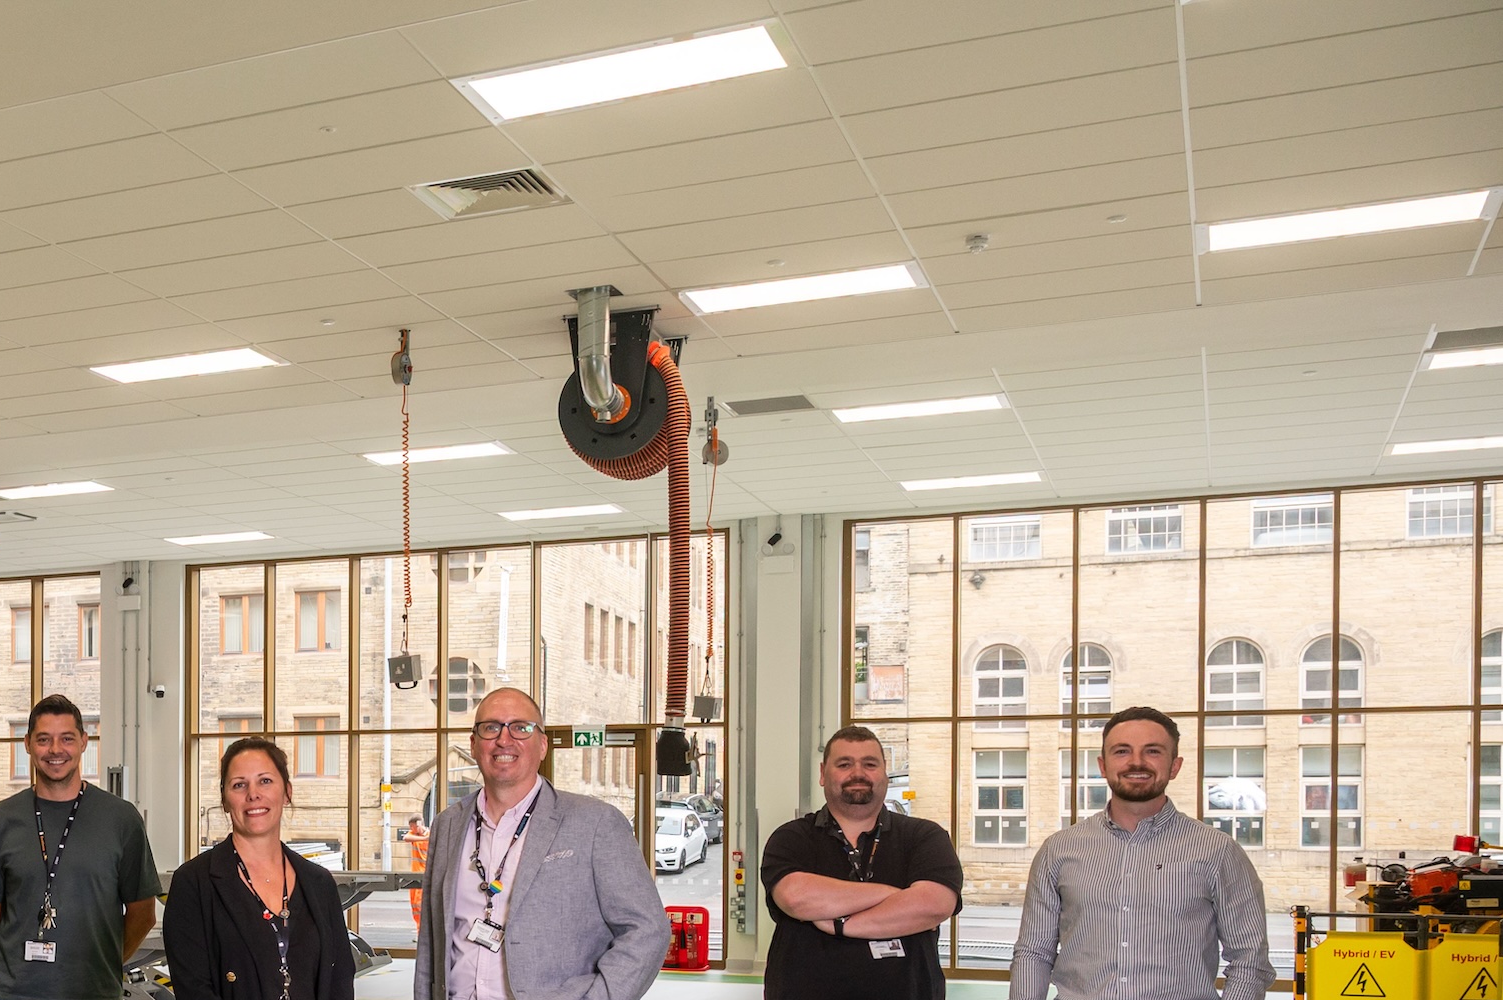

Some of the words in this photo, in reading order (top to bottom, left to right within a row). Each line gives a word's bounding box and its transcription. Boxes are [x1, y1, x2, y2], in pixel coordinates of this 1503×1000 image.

[1333, 949, 1370, 959] Hybrid
[1379, 950, 1396, 959] EV
[1451, 953, 1491, 964] Hybrid
